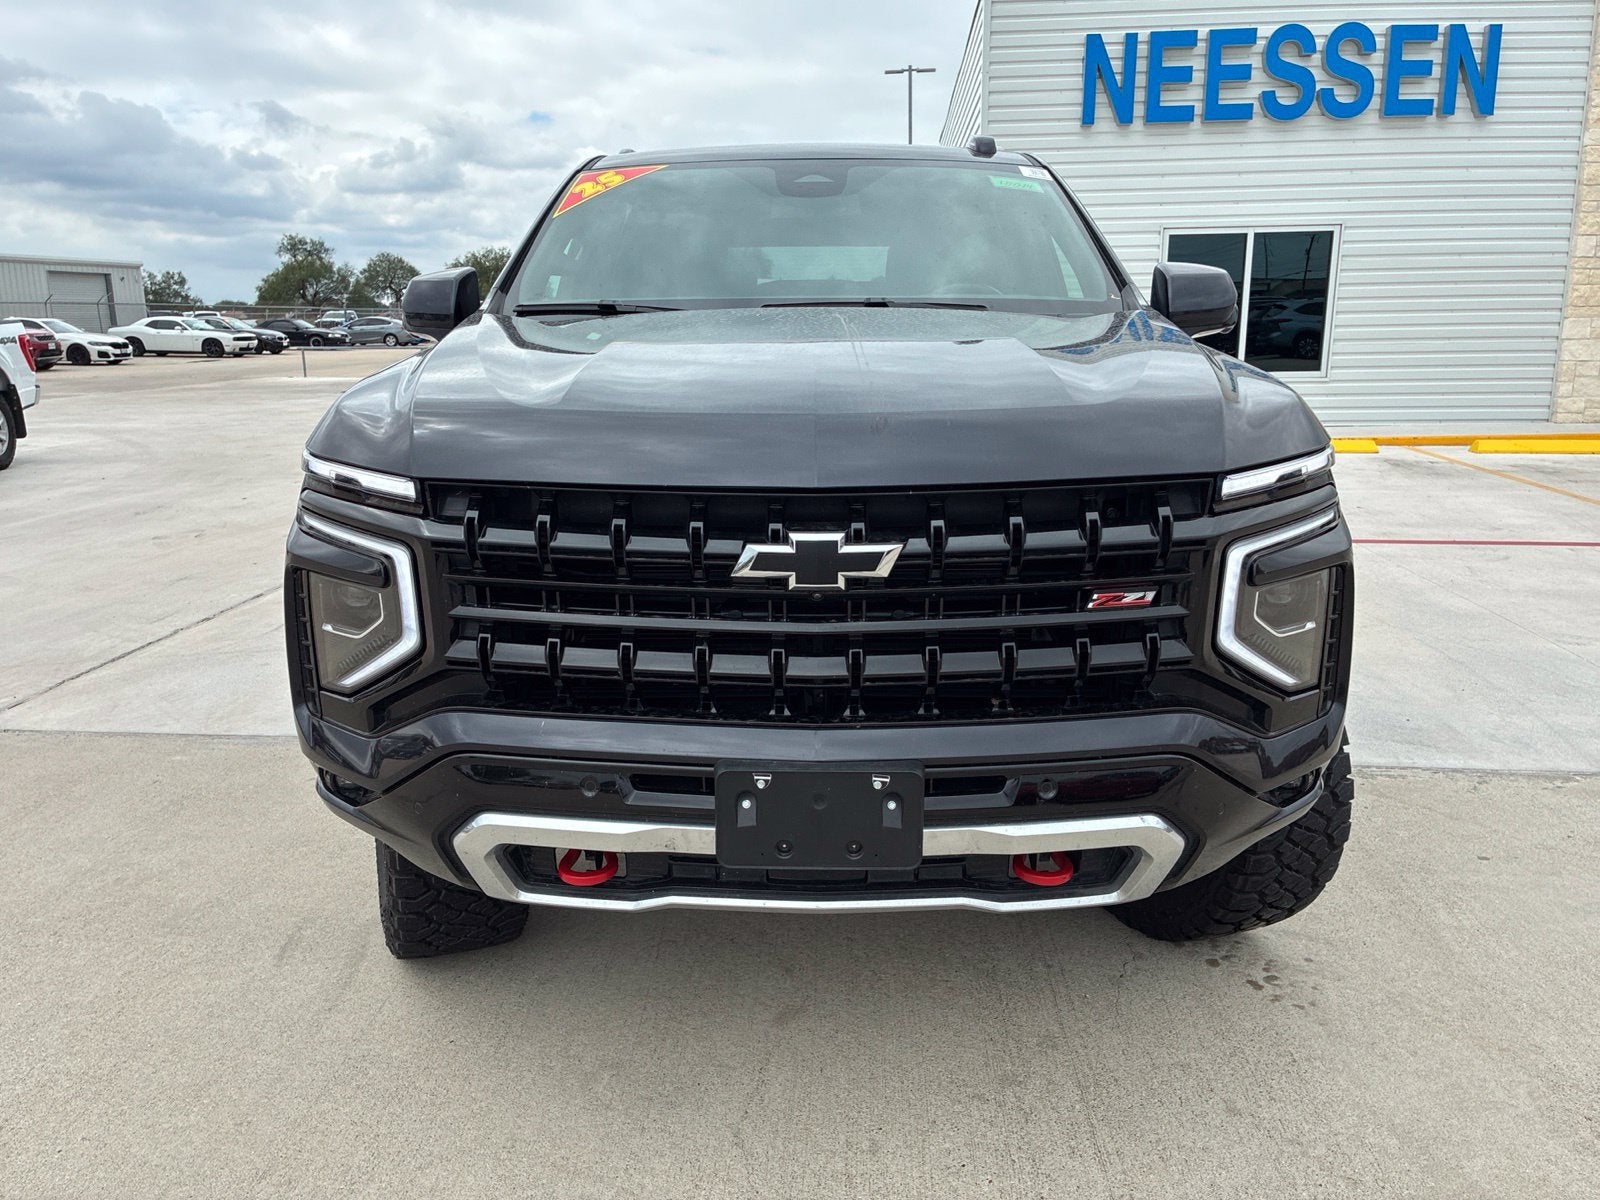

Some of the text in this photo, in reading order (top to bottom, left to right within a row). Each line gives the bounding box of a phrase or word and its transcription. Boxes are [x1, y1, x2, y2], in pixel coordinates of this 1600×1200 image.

[1080, 21, 1503, 127] NEESSEN
[571, 171, 625, 198] 25
[1087, 591, 1157, 608] Z71
